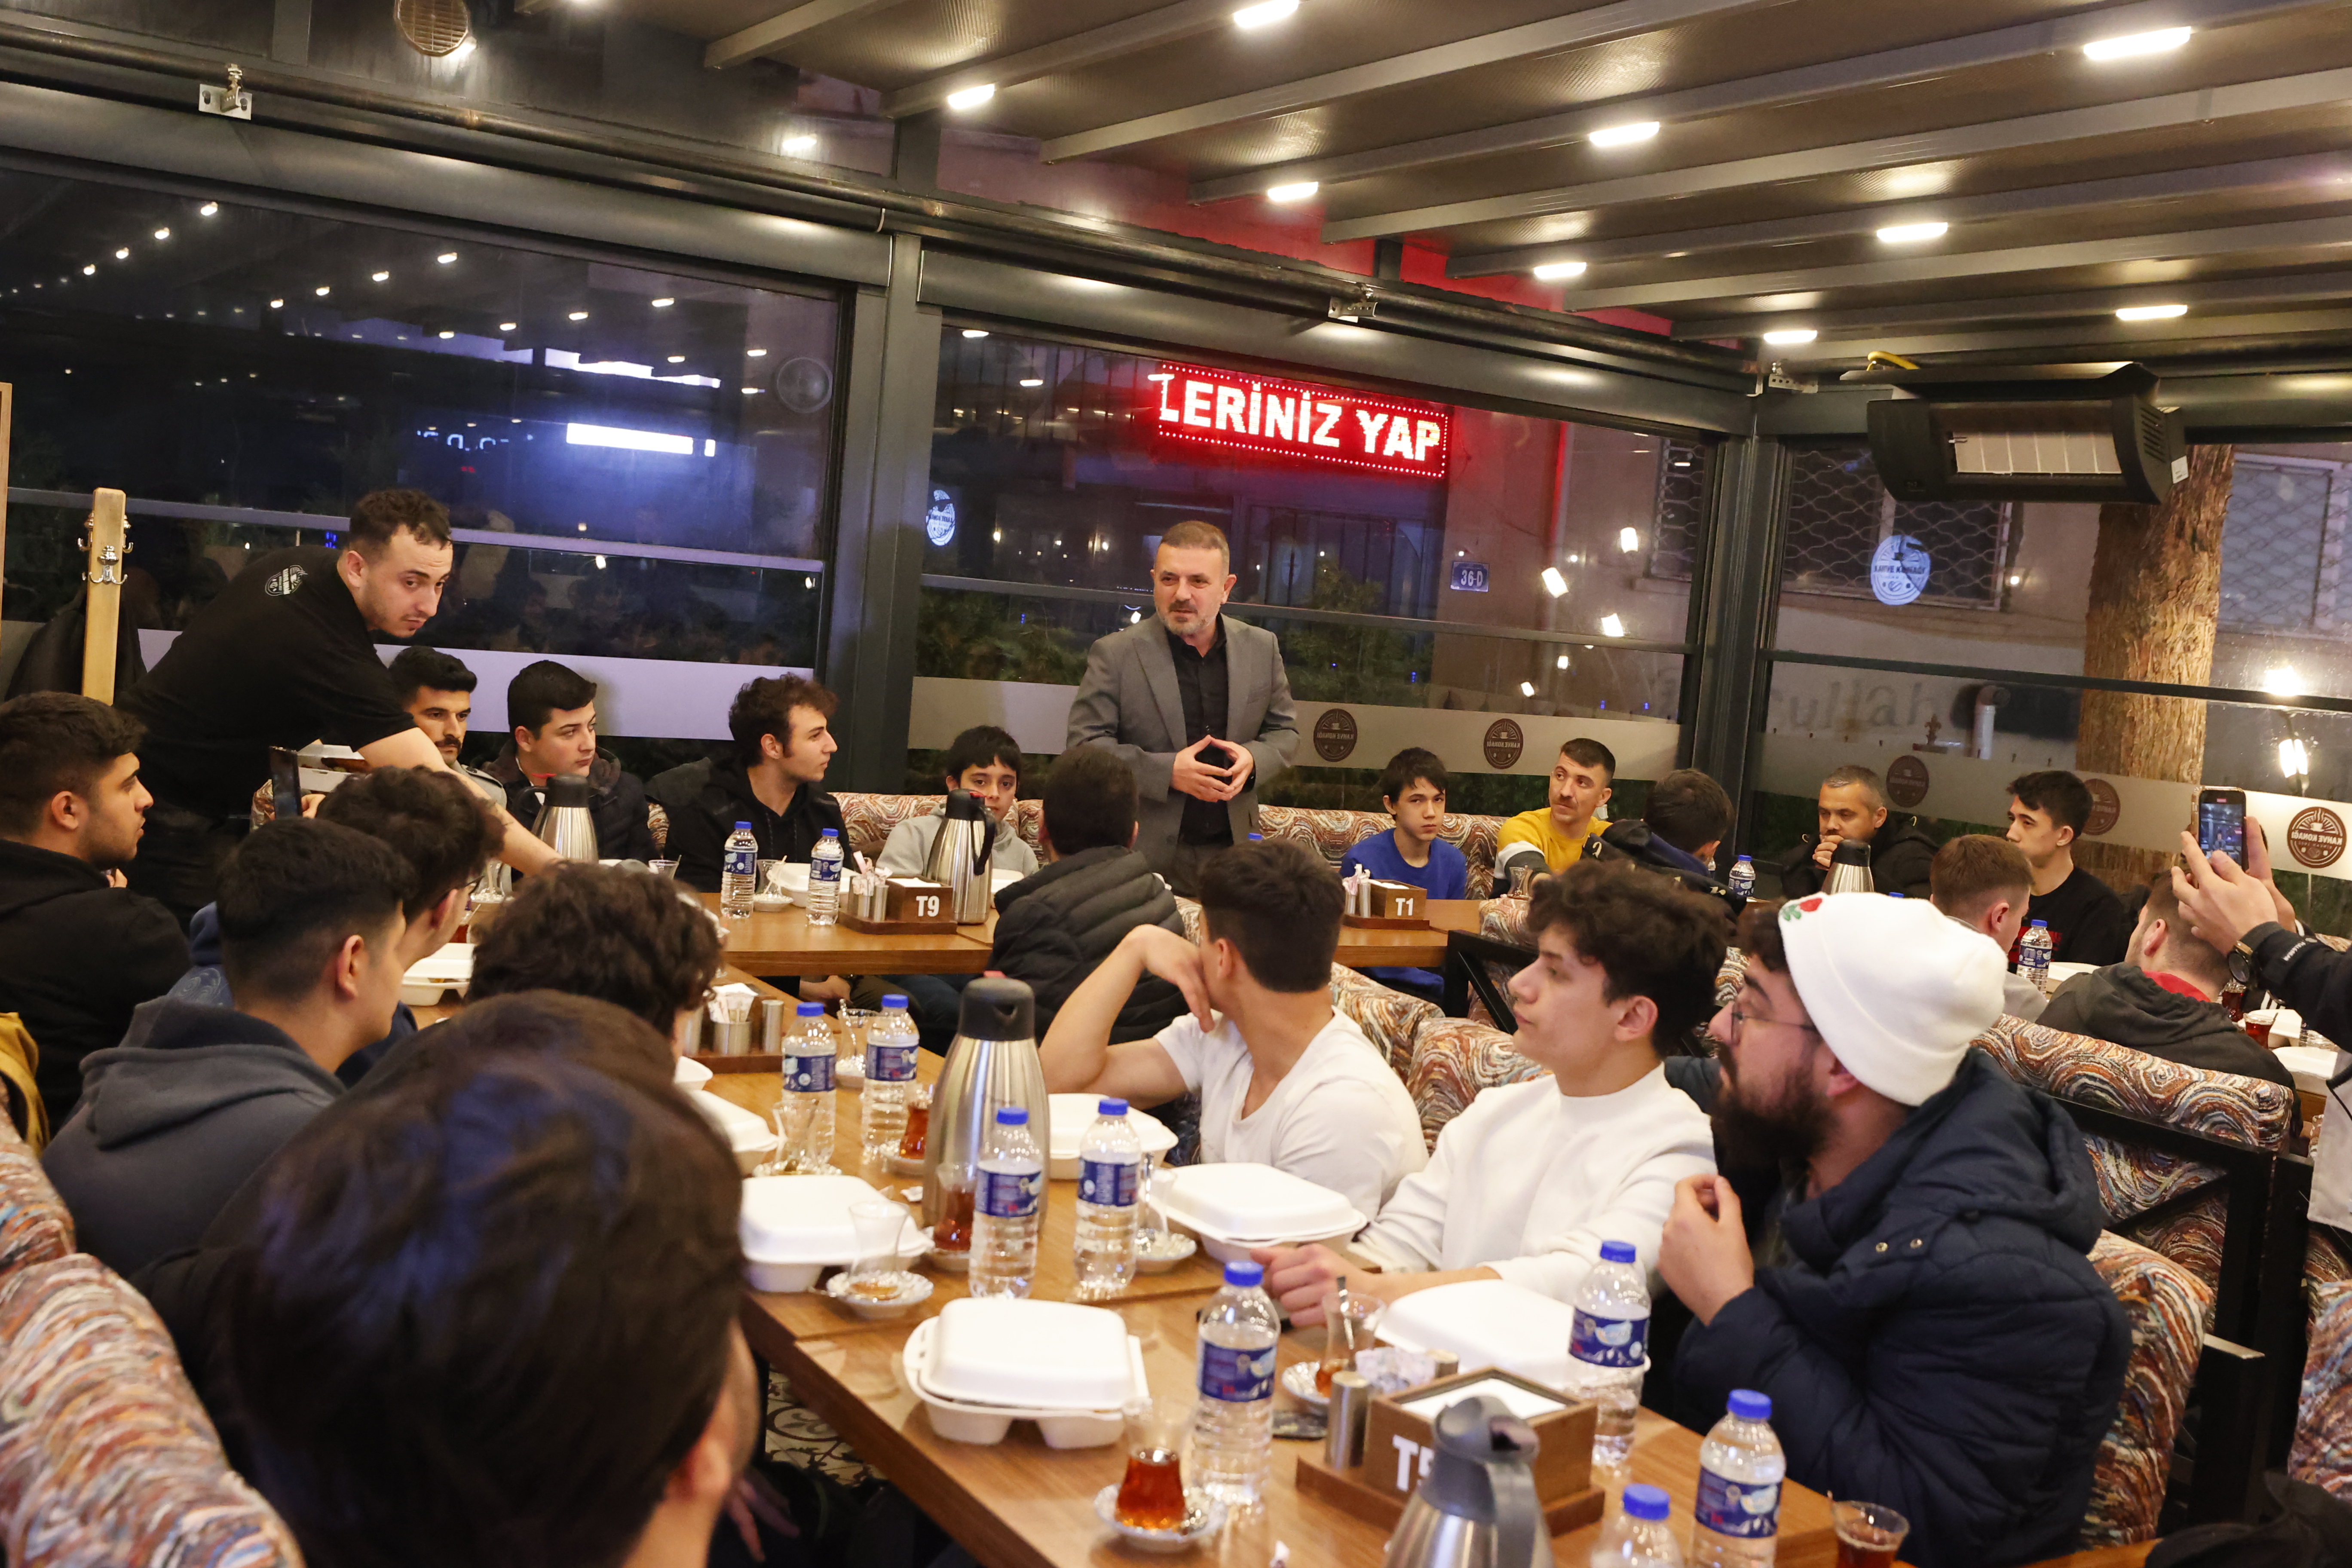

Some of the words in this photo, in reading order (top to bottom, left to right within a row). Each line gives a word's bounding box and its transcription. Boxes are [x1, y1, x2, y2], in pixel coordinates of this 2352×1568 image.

[1355, 410, 1440, 462] YAP
[1461, 570, 1483, 587] 36-D
[916, 895, 940, 917] T9
[1395, 897, 1414, 916] T1
